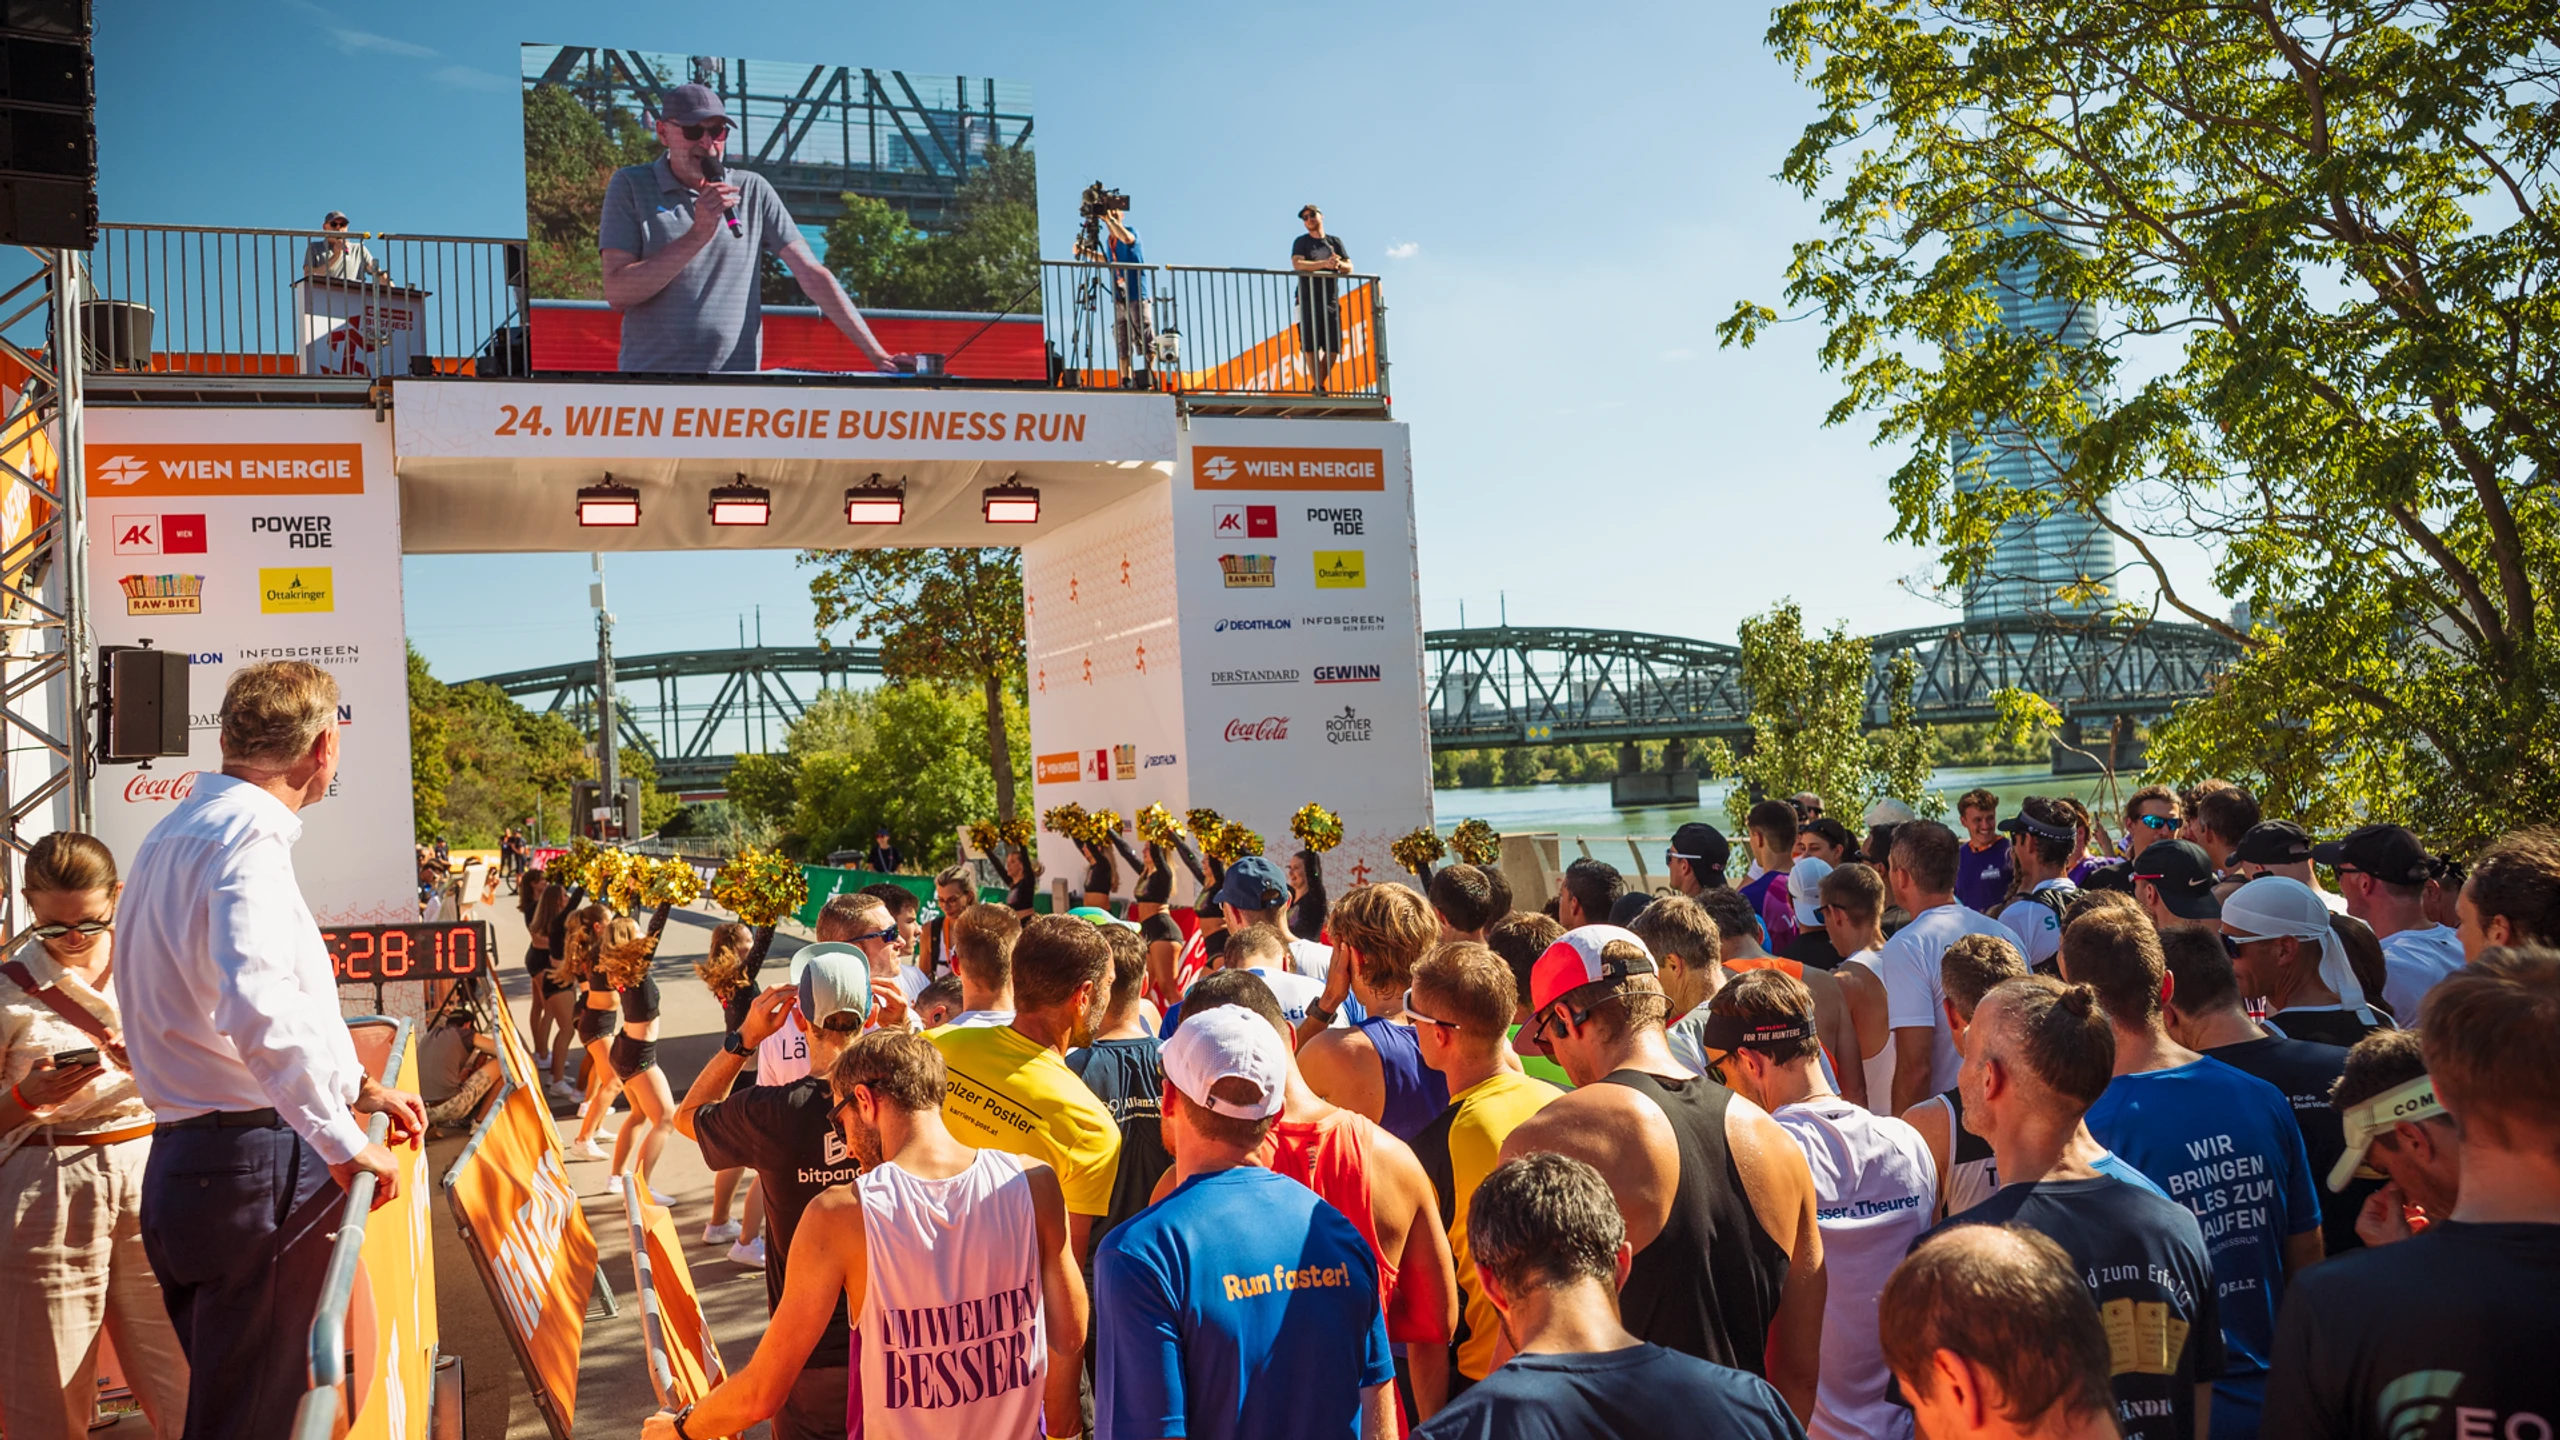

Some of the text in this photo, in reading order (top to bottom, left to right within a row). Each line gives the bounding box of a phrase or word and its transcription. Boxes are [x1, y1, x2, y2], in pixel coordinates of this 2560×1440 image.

[495, 405, 1086, 442] 24. WIEN ENERGIE BUSINESS RUN
[159, 459, 352, 480] WIEN ENERGIE
[1243, 460, 1376, 478] WIEN ENERGIE
[252, 516, 332, 532] POWER
[1218, 513, 1242, 530] AK
[1307, 508, 1363, 522] POWER
[119, 525, 154, 545] AK
[176, 530, 194, 538] WIEN
[1333, 522, 1365, 535] ADE
[289, 532, 333, 548] ADE
[1318, 568, 1361, 580] Ottakringer
[266, 589, 326, 602] Ottakringer
[1230, 618, 1292, 631] DECATHLON
[1302, 615, 1385, 625] INFOSCREEN
[240, 645, 359, 659] INFOSCREEN
[1313, 664, 1381, 681] GEWINN
[1224, 716, 1291, 743] Coca-Cola
[1326, 731, 1371, 745] QUELLE
[1742, 1028, 1801, 1041] FOR THE HUNTERS
[946, 1081, 1036, 1135] olzer Postler
[2185, 1134, 2235, 1161] WIR
[2168, 1155, 2264, 1195] BRINGEN
[2233, 1179, 2274, 1205] ZUM
[1816, 1206, 1849, 1221] sser
[1855, 1195, 1920, 1217] Theurer
[2204, 1207, 2266, 1241] AUFEN
[1223, 1262, 1351, 1302] Run faster!
[2101, 1265, 2140, 1283] zum
[494, 1233, 547, 1342] IEN
[883, 1324, 1038, 1410] BESSER!
